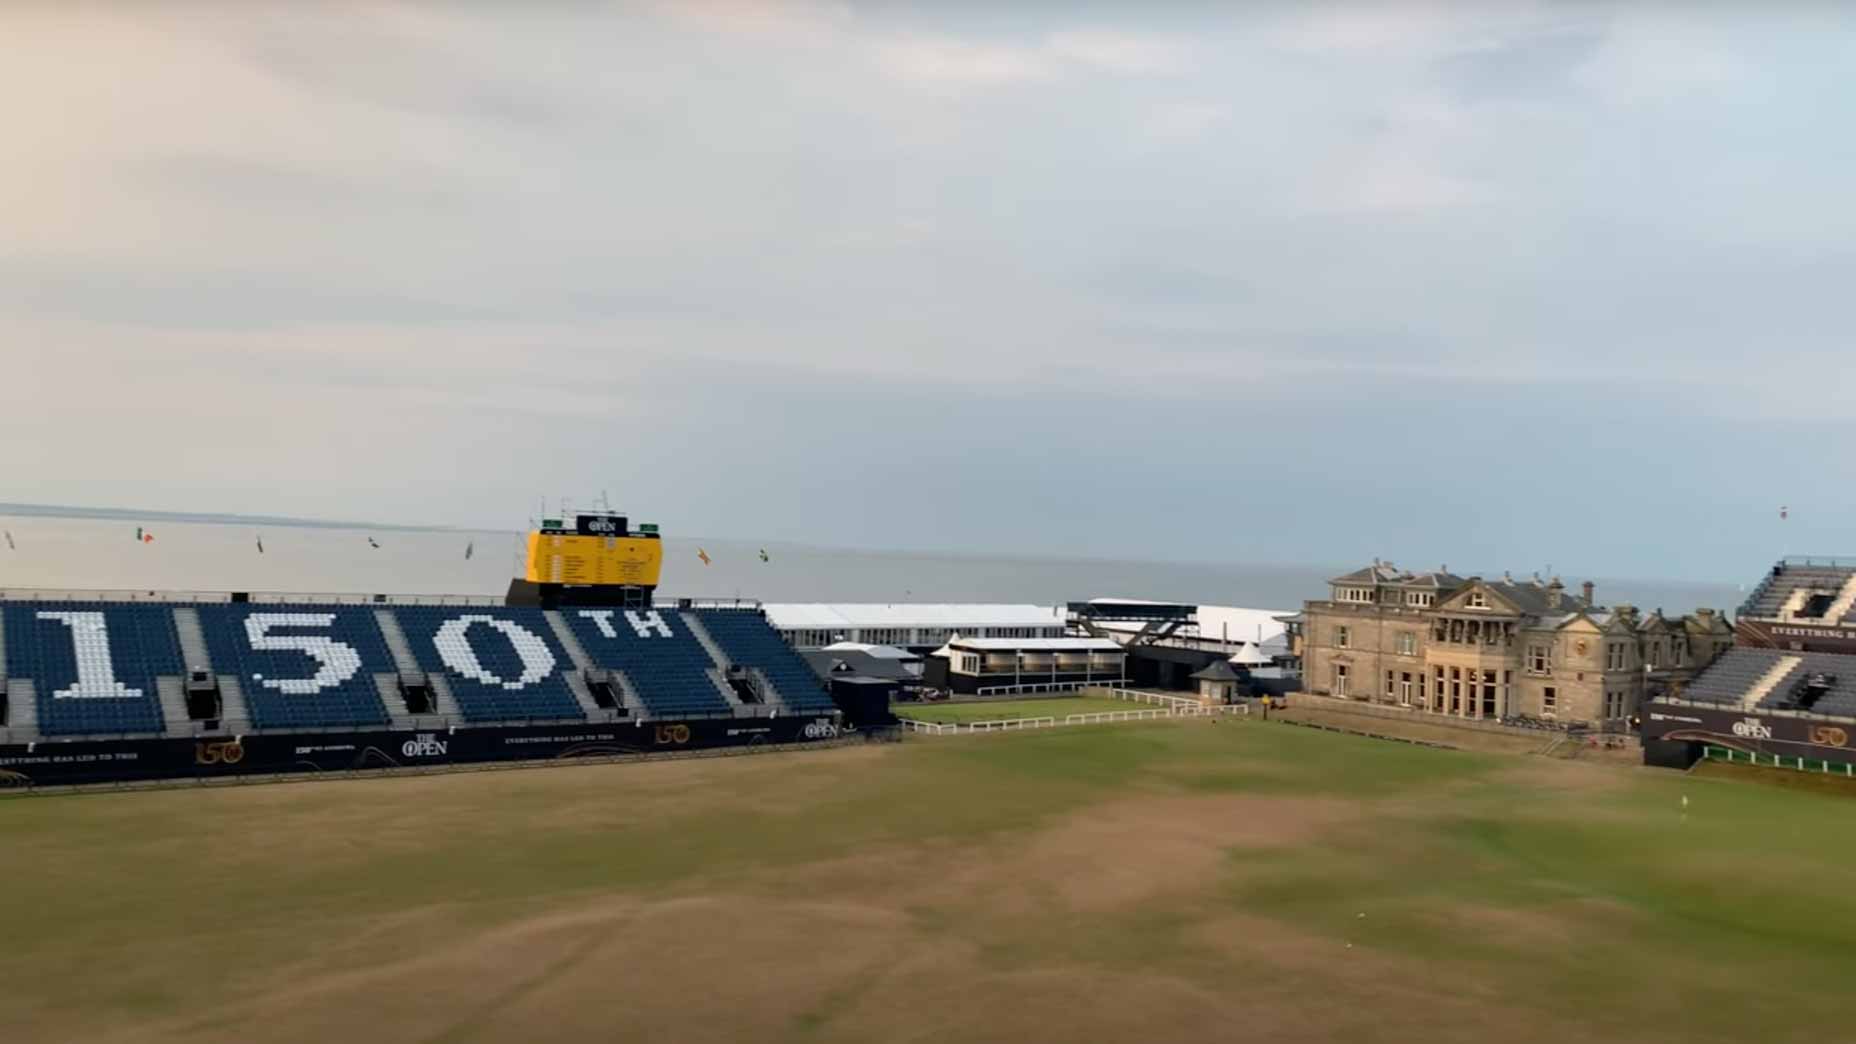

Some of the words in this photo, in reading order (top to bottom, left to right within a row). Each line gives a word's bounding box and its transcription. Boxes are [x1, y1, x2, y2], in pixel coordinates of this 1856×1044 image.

[588, 521, 617, 532] OPEN
[1772, 626, 1844, 638] EVERYTHING
[805, 723, 839, 738] OPEN
[1732, 721, 1772, 738] OPEN
[416, 733, 436, 743] THE
[402, 740, 448, 757] OPEN
